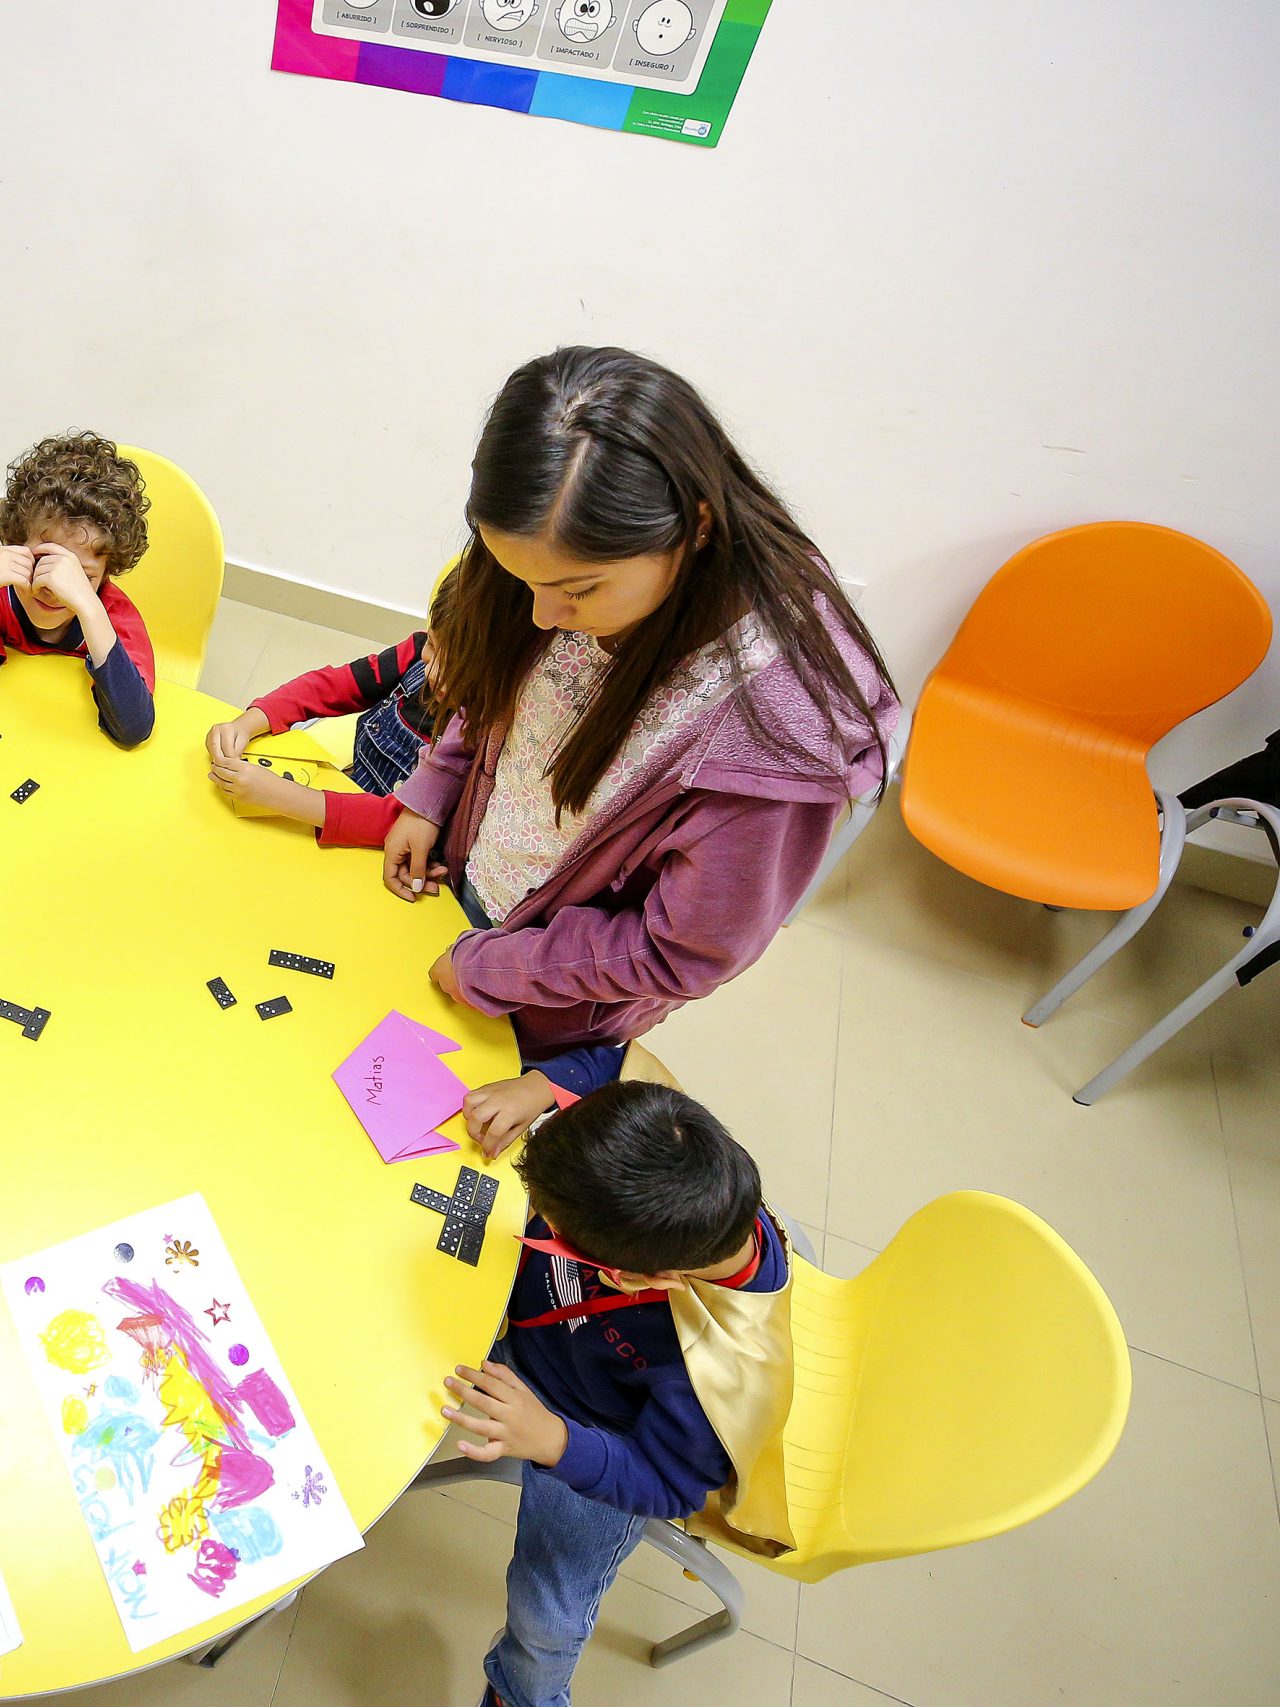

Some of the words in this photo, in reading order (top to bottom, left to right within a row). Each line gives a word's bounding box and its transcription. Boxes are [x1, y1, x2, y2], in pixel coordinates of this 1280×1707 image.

[340, 12, 372, 23] ABURRIDO
[405, 21, 451, 34] SORPRENDIDO
[484, 35, 518, 47] NERVIOSO
[555, 46, 595, 59] IMPACTADO
[634, 58, 669, 71] INSEGURO
[363, 1055, 385, 1106] Matias
